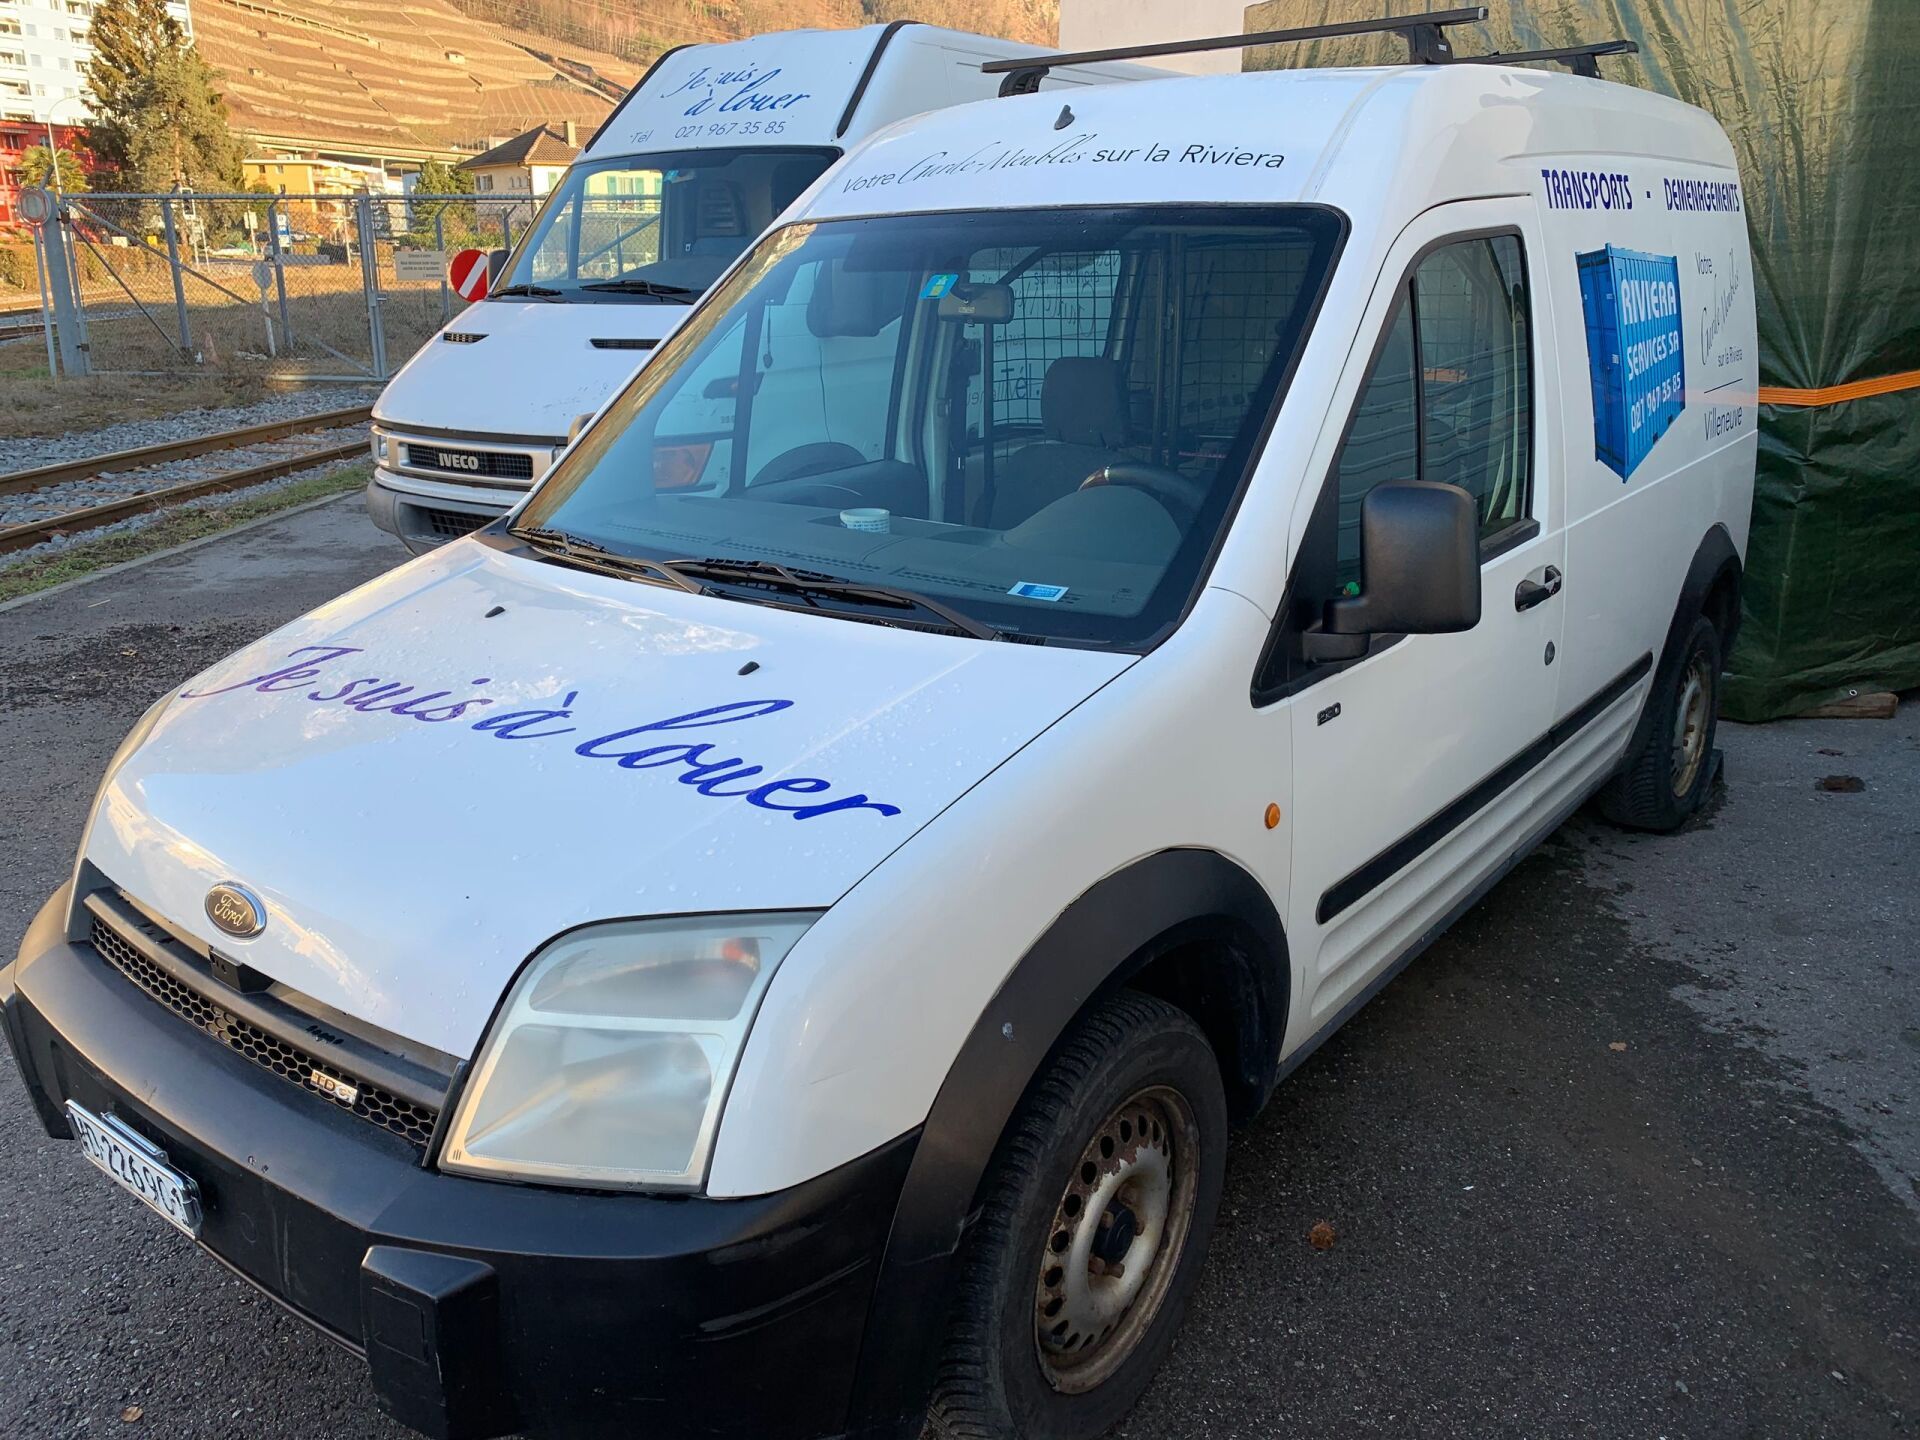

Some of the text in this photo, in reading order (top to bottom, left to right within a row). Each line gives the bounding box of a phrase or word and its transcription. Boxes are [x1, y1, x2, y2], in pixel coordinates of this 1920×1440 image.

[719, 68, 811, 113] louer
[675, 125, 703, 140] 021
[709, 122, 738, 137] 967
[739, 121, 760, 135] 35
[764, 120, 786, 134] 85
[842, 171, 895, 195] Votre
[1091, 144, 1145, 164] sur
[1145, 142, 1168, 164] la
[1178, 143, 1286, 170] Riviera
[1541, 169, 1740, 212] TRANSPORTS DEMENAGEMENTS
[1621, 278, 1678, 326] RIVIERA
[1626, 330, 1680, 381] SERVICES SA
[1631, 371, 1681, 434] 021 967 35 85
[1704, 405, 1743, 441] Villeneuve
[438, 452, 479, 470] IVECO
[181, 644, 903, 821] Je suis à louer
[214, 893, 247, 927] Ford
